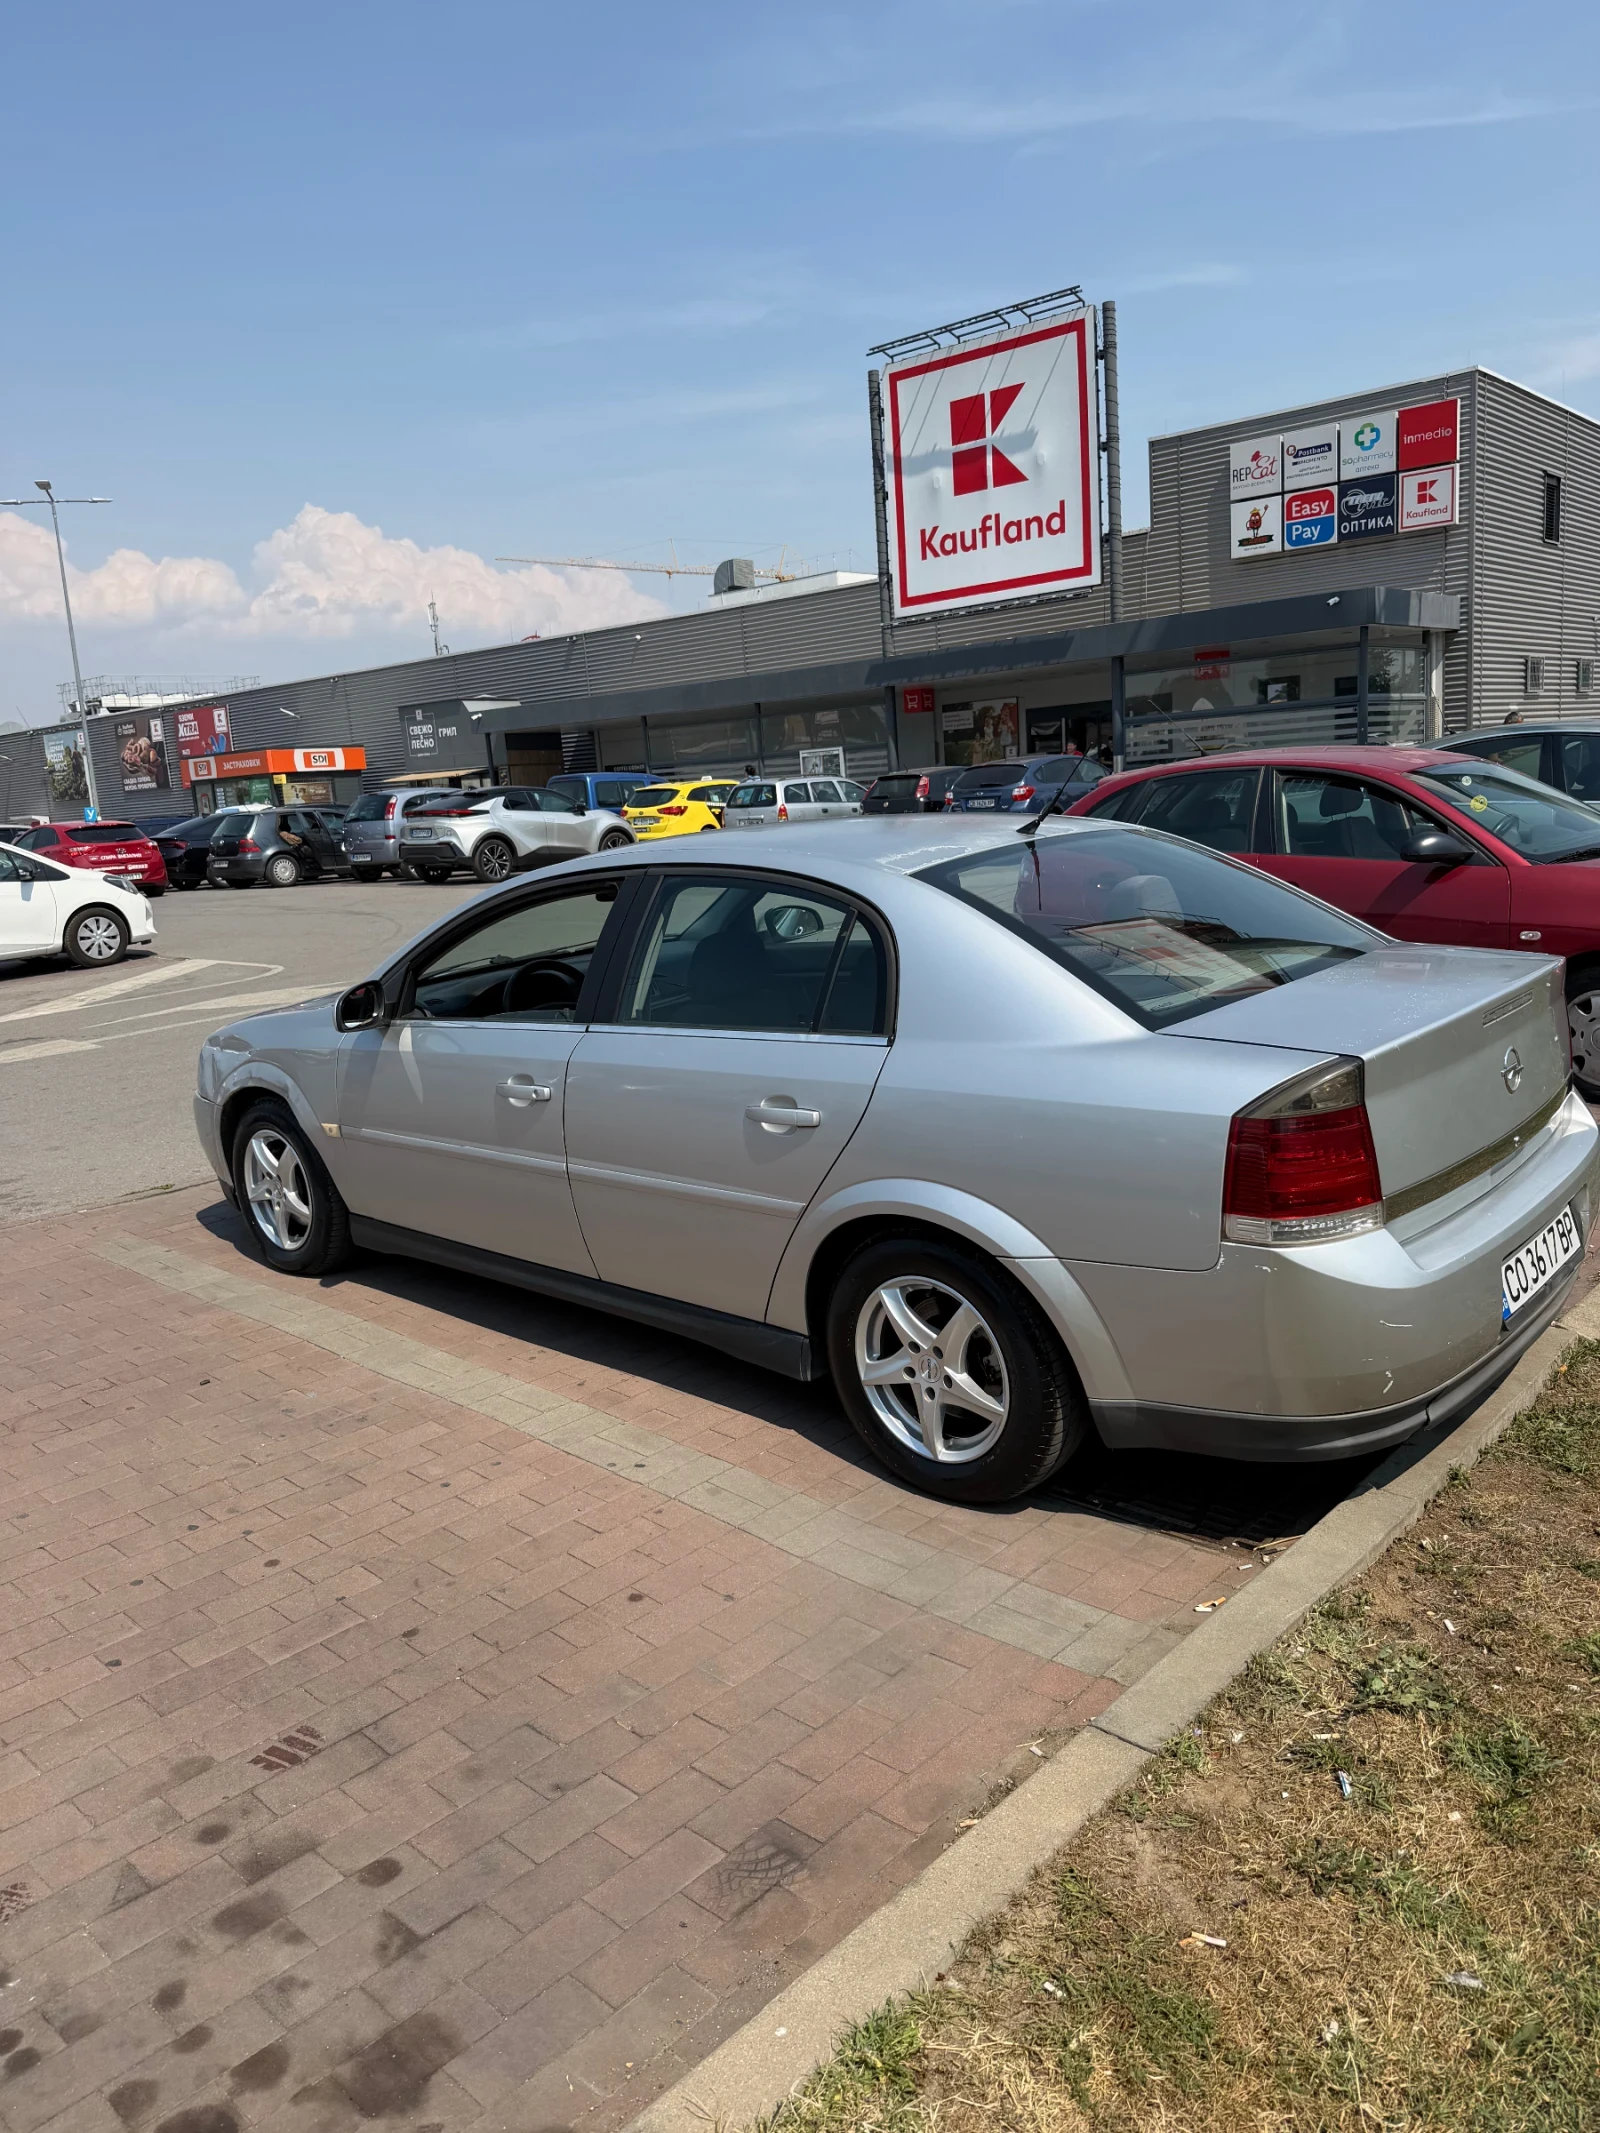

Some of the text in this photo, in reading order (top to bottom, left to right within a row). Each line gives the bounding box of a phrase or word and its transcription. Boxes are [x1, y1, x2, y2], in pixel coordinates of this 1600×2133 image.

[1404, 427, 1452, 445] inmedio
[1298, 444, 1330, 457] Postbank
[1355, 464, 1380, 473] аптека
[1292, 500, 1329, 518] Easy
[1406, 505, 1448, 519] Kaufland
[919, 499, 1066, 561] Kaufland
[1341, 515, 1394, 534] ОПТИКА
[1292, 525, 1321, 541] Pay
[178, 722, 199, 738] XTRA
[410, 724, 433, 735] СВЕЖО
[438, 726, 457, 737] ГРИЛ
[411, 738, 435, 749] ЛЕСНО
[222, 758, 261, 770] ЗАСТРАХОВКИ
[312, 755, 328, 764] SDI
[86, 809, 95, 819] У
